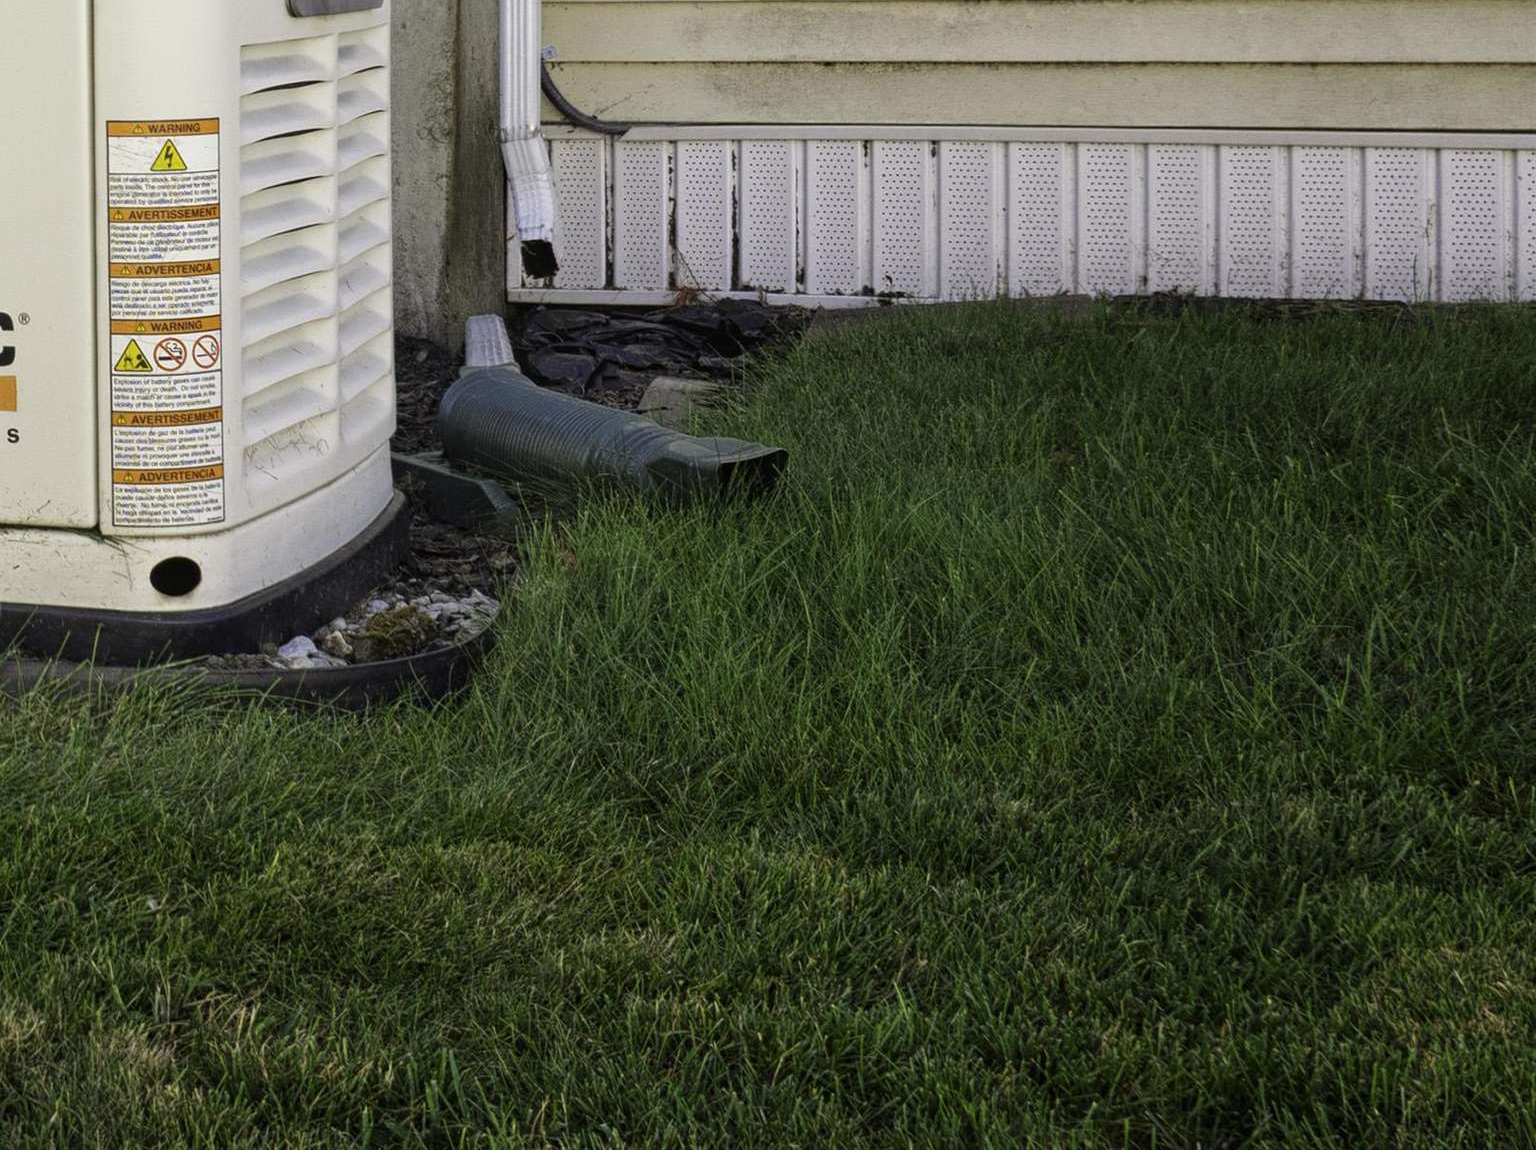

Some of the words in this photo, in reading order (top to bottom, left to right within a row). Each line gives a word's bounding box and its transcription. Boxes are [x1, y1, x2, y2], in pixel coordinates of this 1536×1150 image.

[147, 123, 201, 133] WARNING
[128, 207, 217, 219] AVERTISSEMENT
[136, 263, 212, 274] ADVERTENCIA
[151, 321, 202, 331] WARNING
[131, 411, 219, 424] AVERTISSEMENT
[139, 469, 216, 481] ADVERTENCIA
